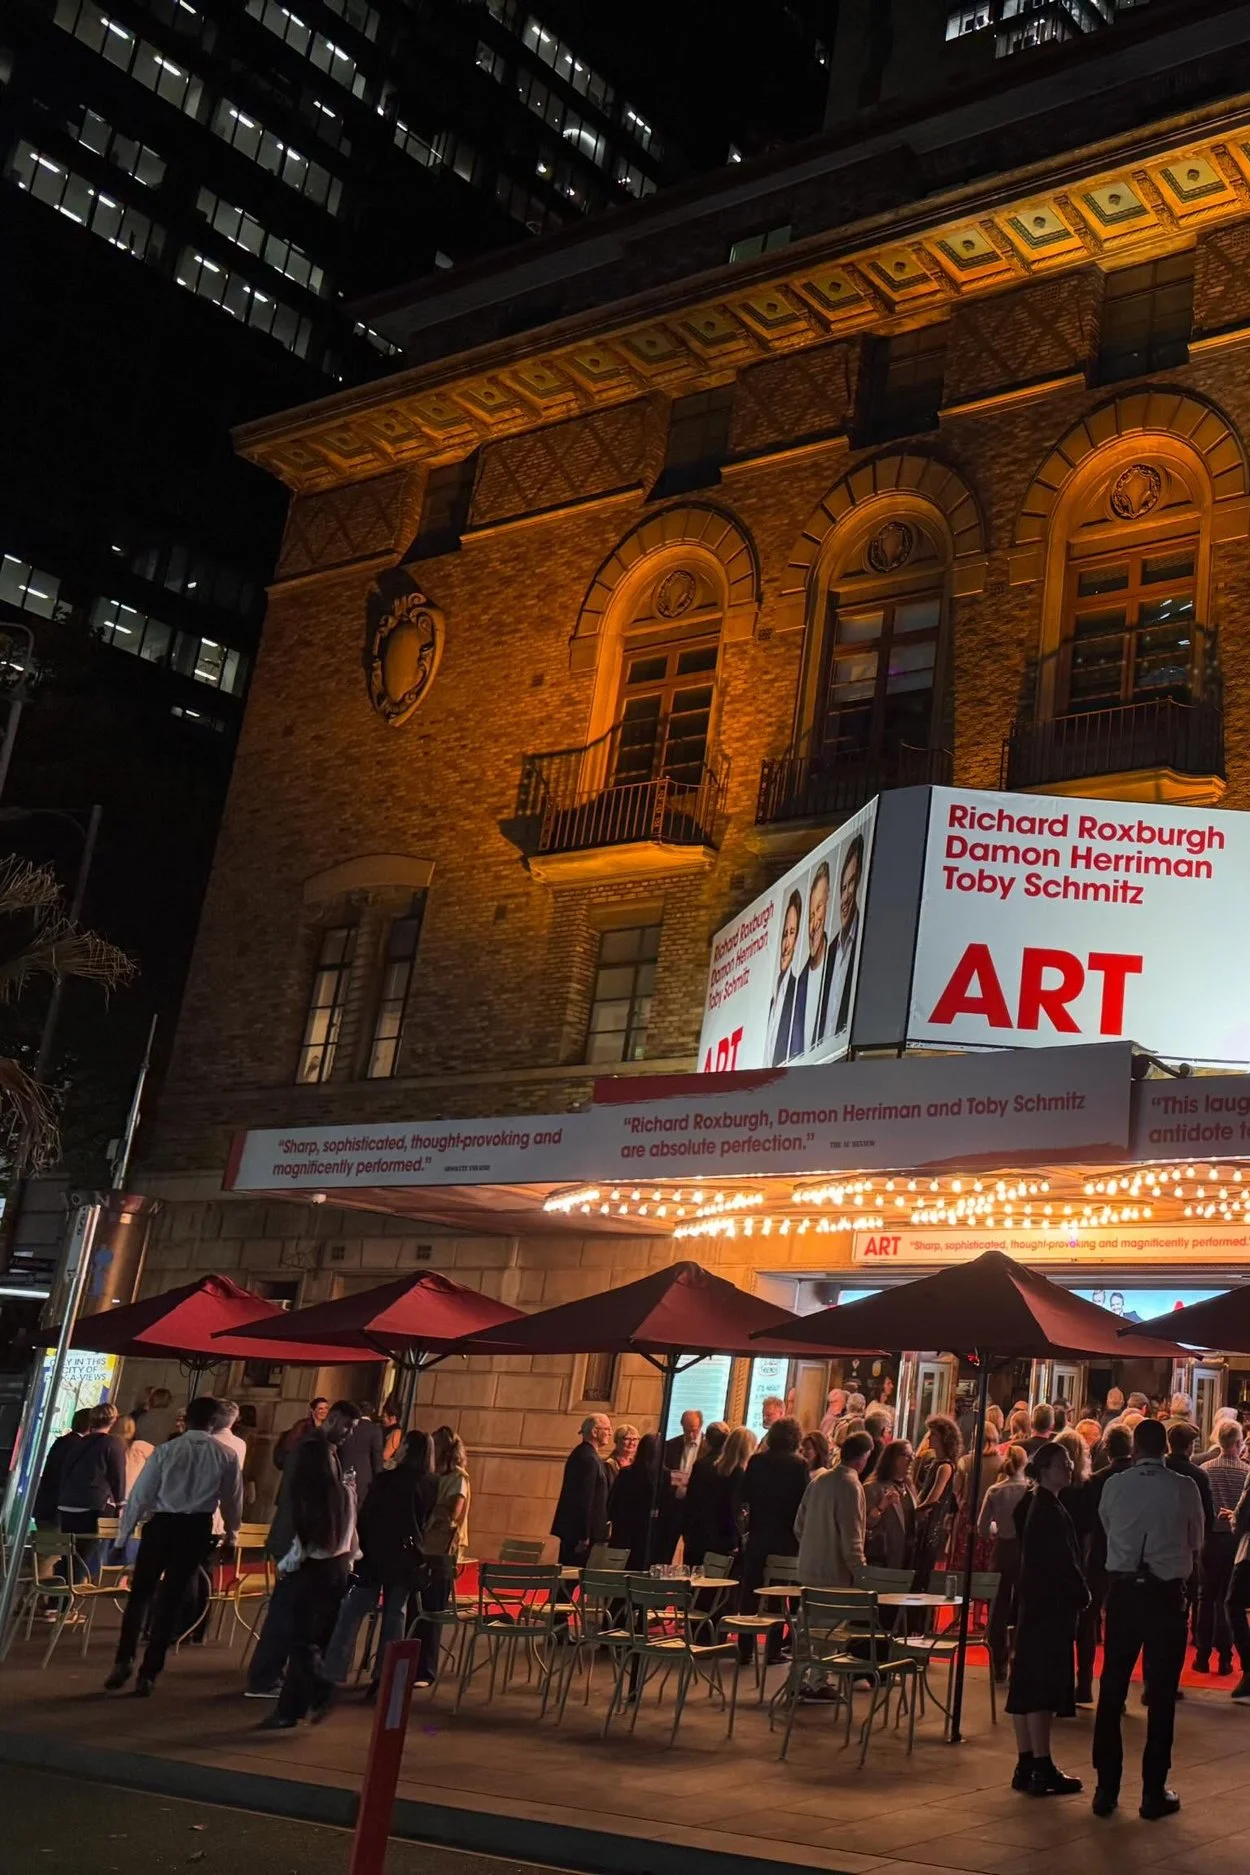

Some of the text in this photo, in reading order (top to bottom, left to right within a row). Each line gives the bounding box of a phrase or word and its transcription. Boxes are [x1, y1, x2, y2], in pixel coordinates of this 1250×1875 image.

[949, 804, 1224, 854] Richard Roxburgh
[945, 835, 1212, 878] Damon Herriman
[943, 866, 1143, 904] Toby Schmitz
[714, 900, 774, 960] Richard Roxburgh
[712, 932, 768, 987] Damon Herriman
[723, 967, 750, 997] Schmitz
[928, 943, 1143, 1036] ART
[624, 1092, 1086, 1133] “Richard Roxburgh, Damon Herriman and Toby Schmitz
[1152, 1096, 1198, 1114] “This
[278, 1128, 563, 1155] “Sharp, sophisticated, thought-provoking and
[621, 1133, 815, 1158] are absolute perfection.”
[1150, 1122, 1233, 1143] antidote
[273, 1156, 432, 1178] magnificently performed.”
[864, 1236, 902, 1256] ART
[910, 1241, 943, 1253] “Sharp,
[945, 1240, 1008, 1254] sophisticated,
[1011, 1239, 1096, 1251] thought-provoking
[1099, 1237, 1118, 1248] and
[1121, 1237, 1189, 1250] magnificently
[75, 1358, 84, 1366] IN
[87, 1358, 106, 1366] THIS
[86, 1366, 98, 1374] OF
